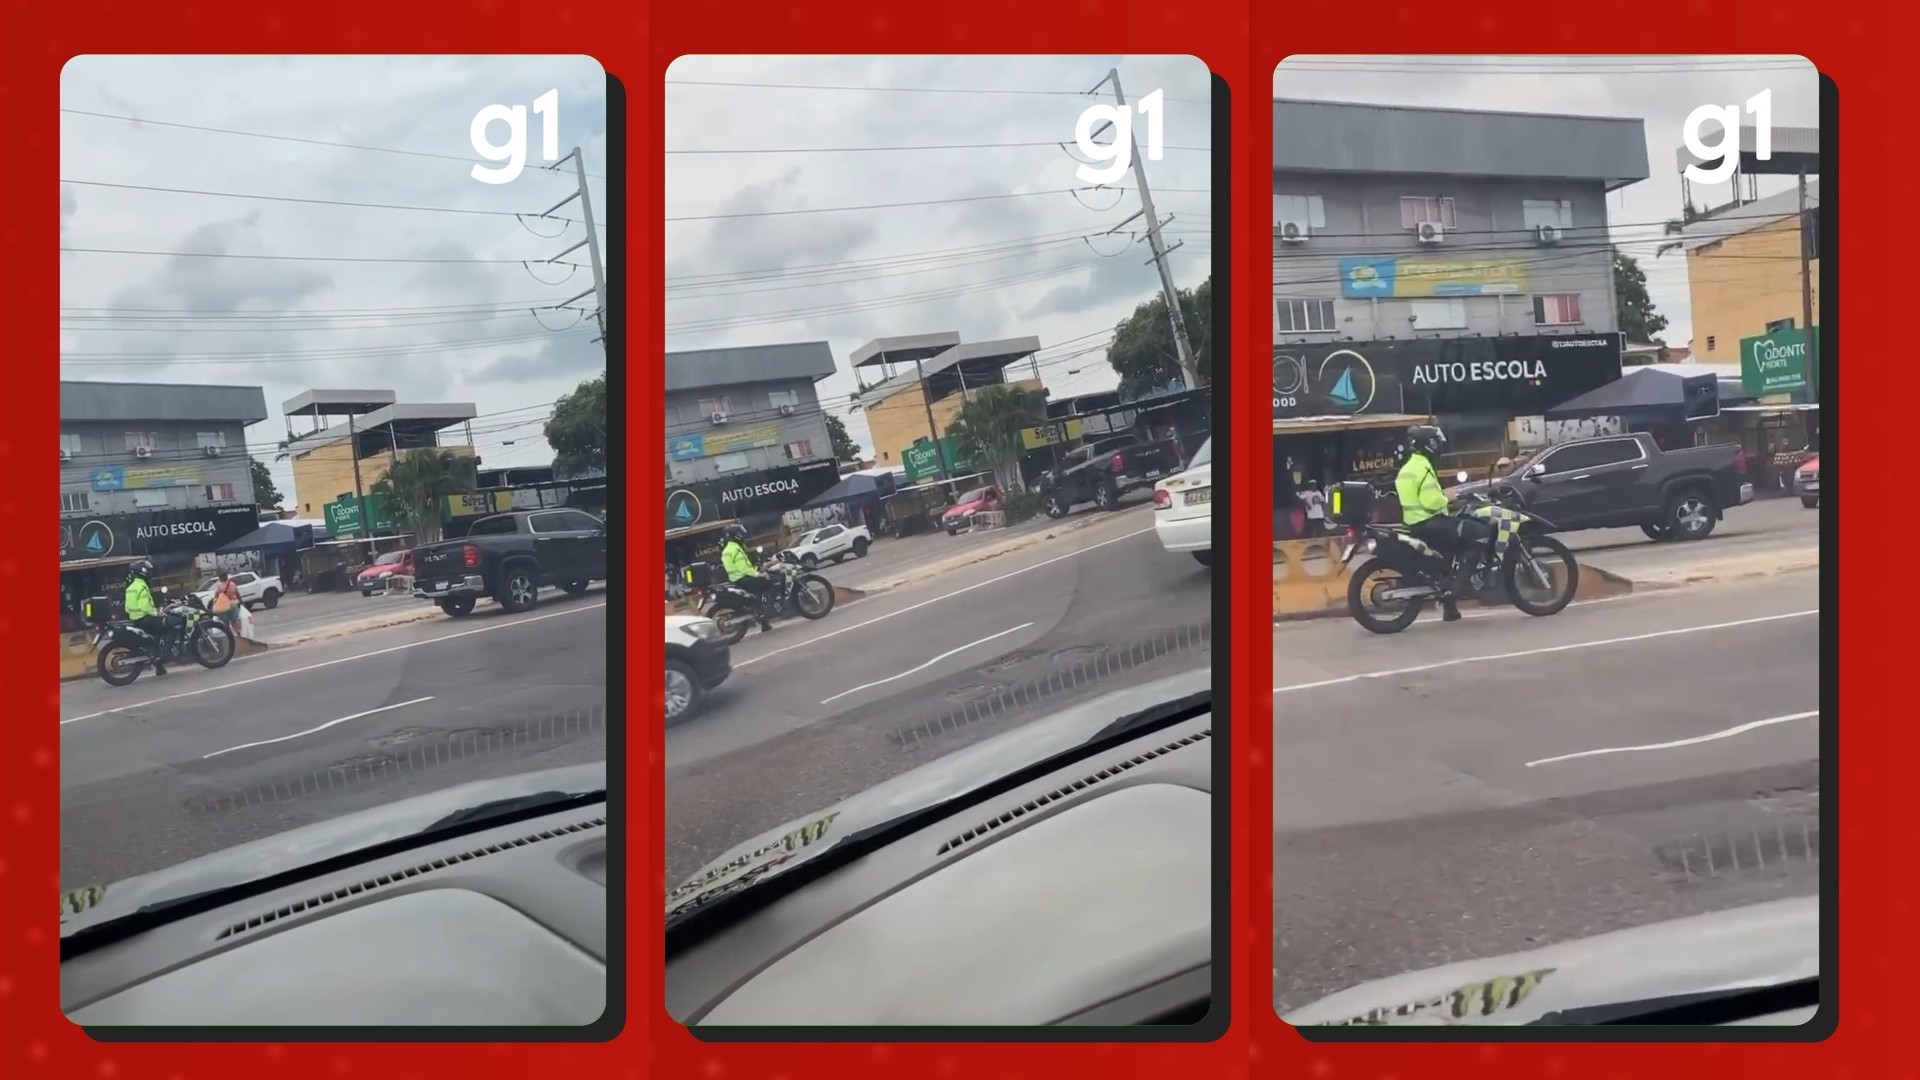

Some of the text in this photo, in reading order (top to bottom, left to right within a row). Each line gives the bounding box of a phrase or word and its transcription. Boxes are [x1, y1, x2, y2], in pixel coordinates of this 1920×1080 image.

[1412, 359, 1548, 384] AUTO ESCOLA
[722, 478, 799, 503] AUTO ESCOLA
[136, 520, 217, 539] AUTO ESCOLA
